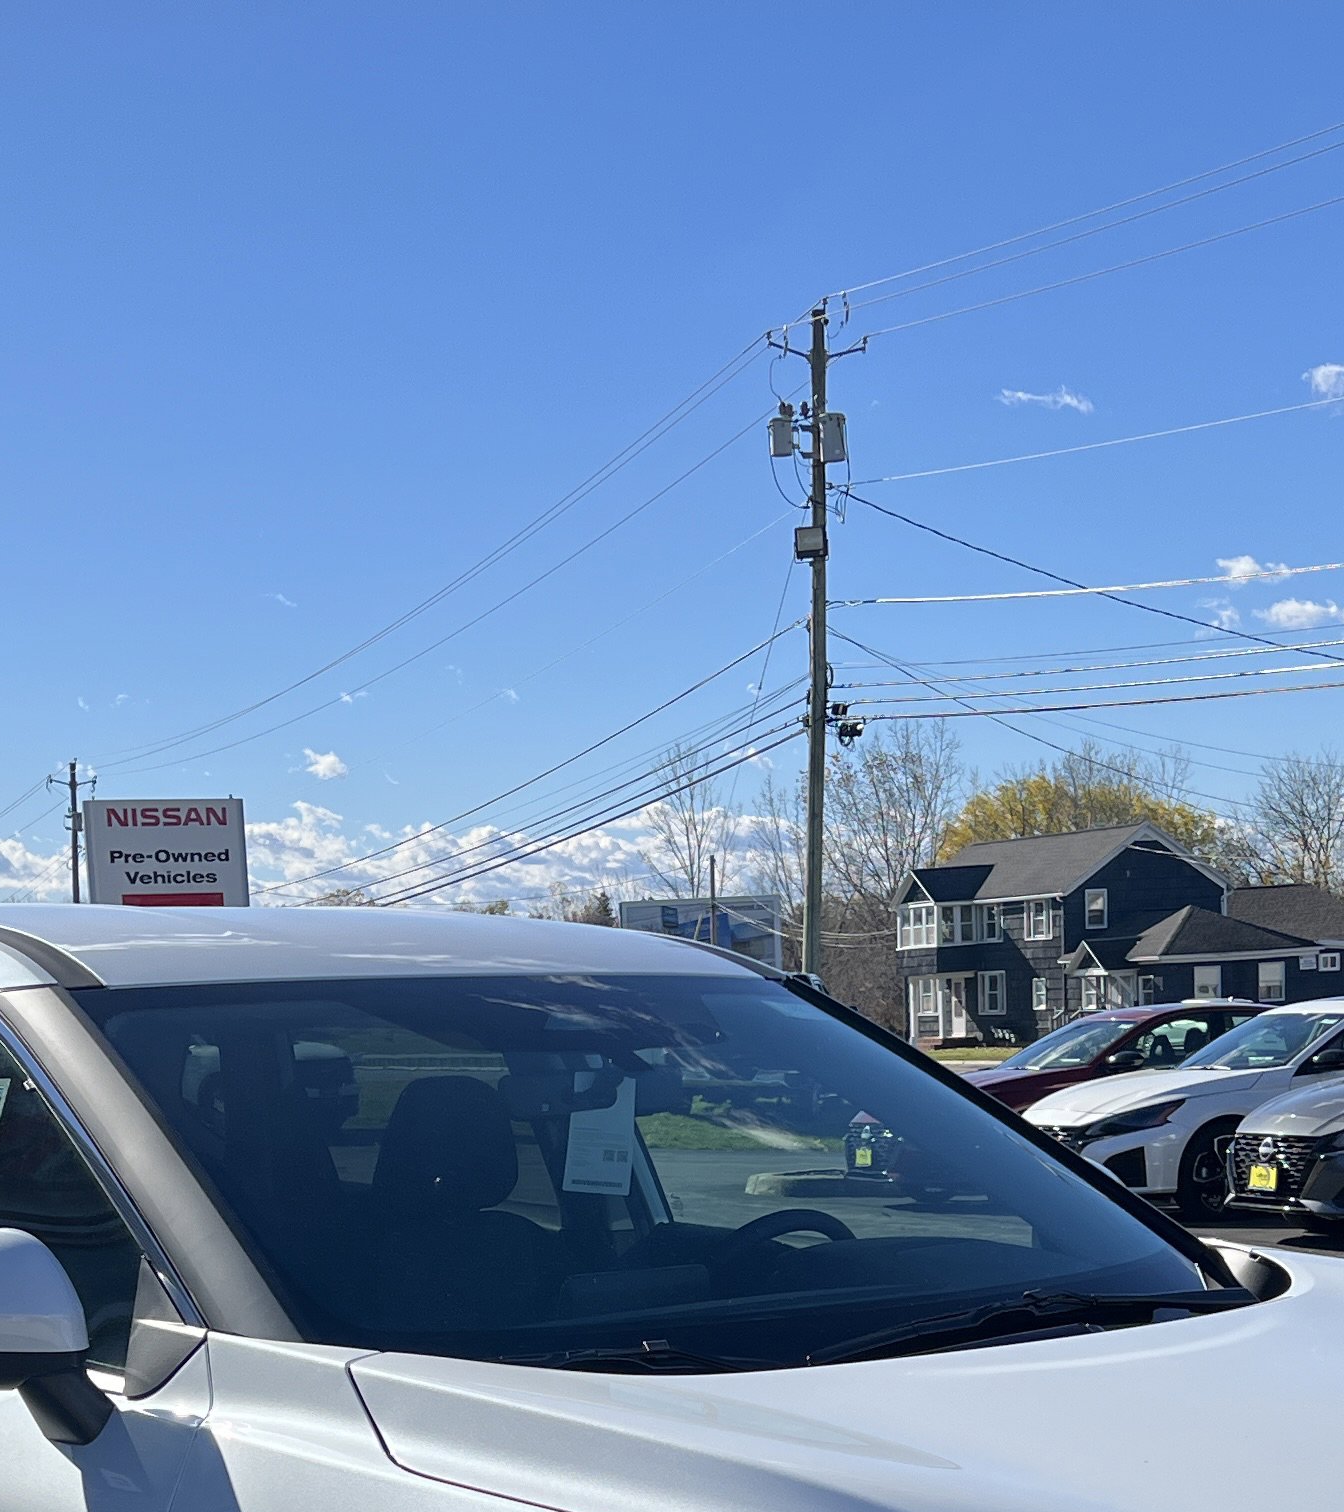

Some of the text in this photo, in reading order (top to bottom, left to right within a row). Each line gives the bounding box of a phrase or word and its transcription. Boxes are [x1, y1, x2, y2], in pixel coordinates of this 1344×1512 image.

[106, 807, 228, 827] NISSAN
[109, 849, 230, 864] Pre-Owned
[125, 871, 218, 885] Vehicles
